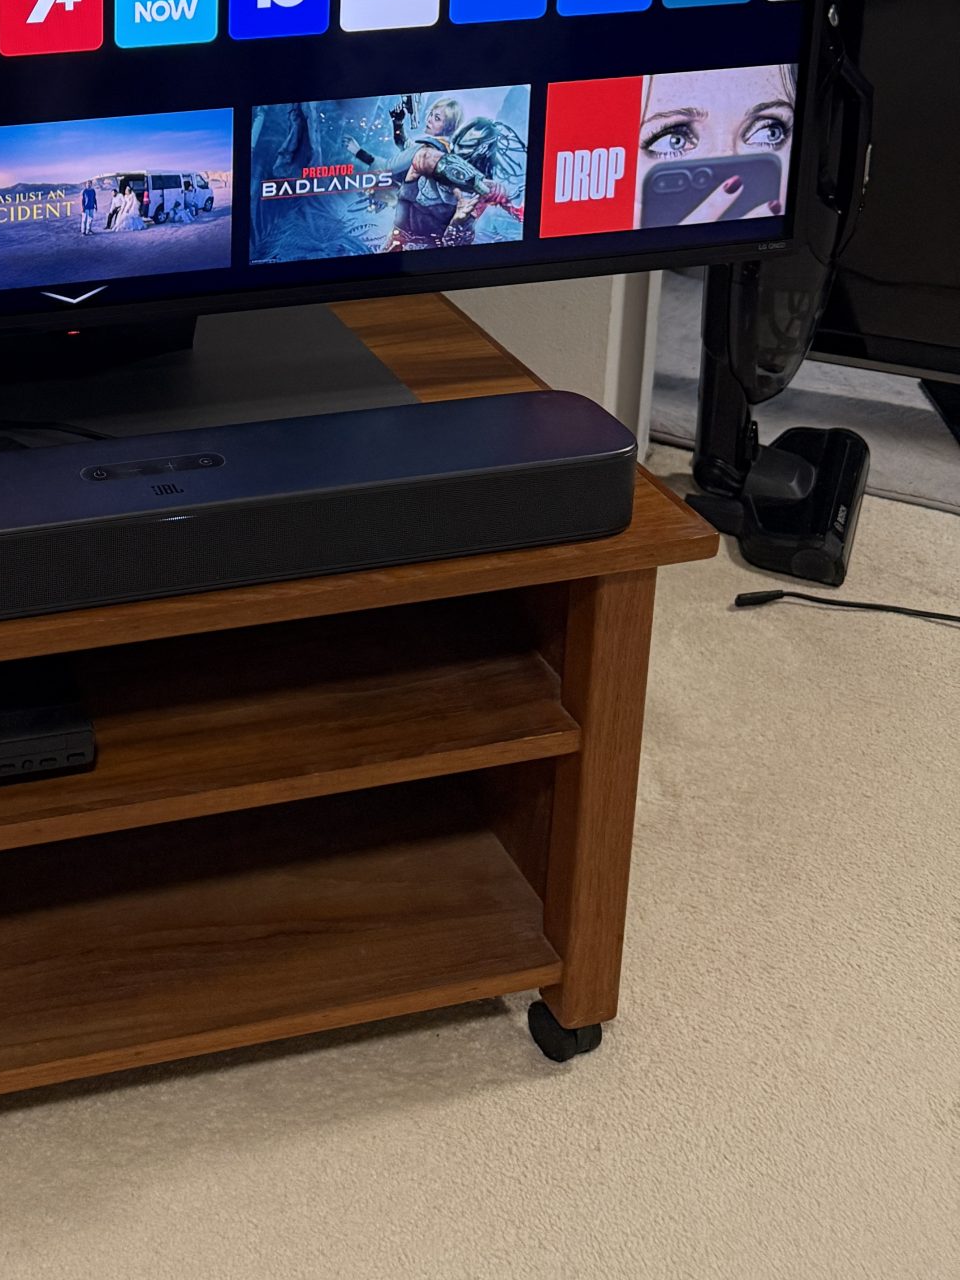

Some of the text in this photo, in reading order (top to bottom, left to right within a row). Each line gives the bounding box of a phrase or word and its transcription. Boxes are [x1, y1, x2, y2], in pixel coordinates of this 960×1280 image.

[302, 164, 355, 179] PREDATOR
[554, 146, 626, 204] DROP
[261, 172, 393, 198] BADLANDS
[15, 191, 46, 203] JUST
[47, 189, 67, 201] AN
[151, 483, 185, 496] JBL
